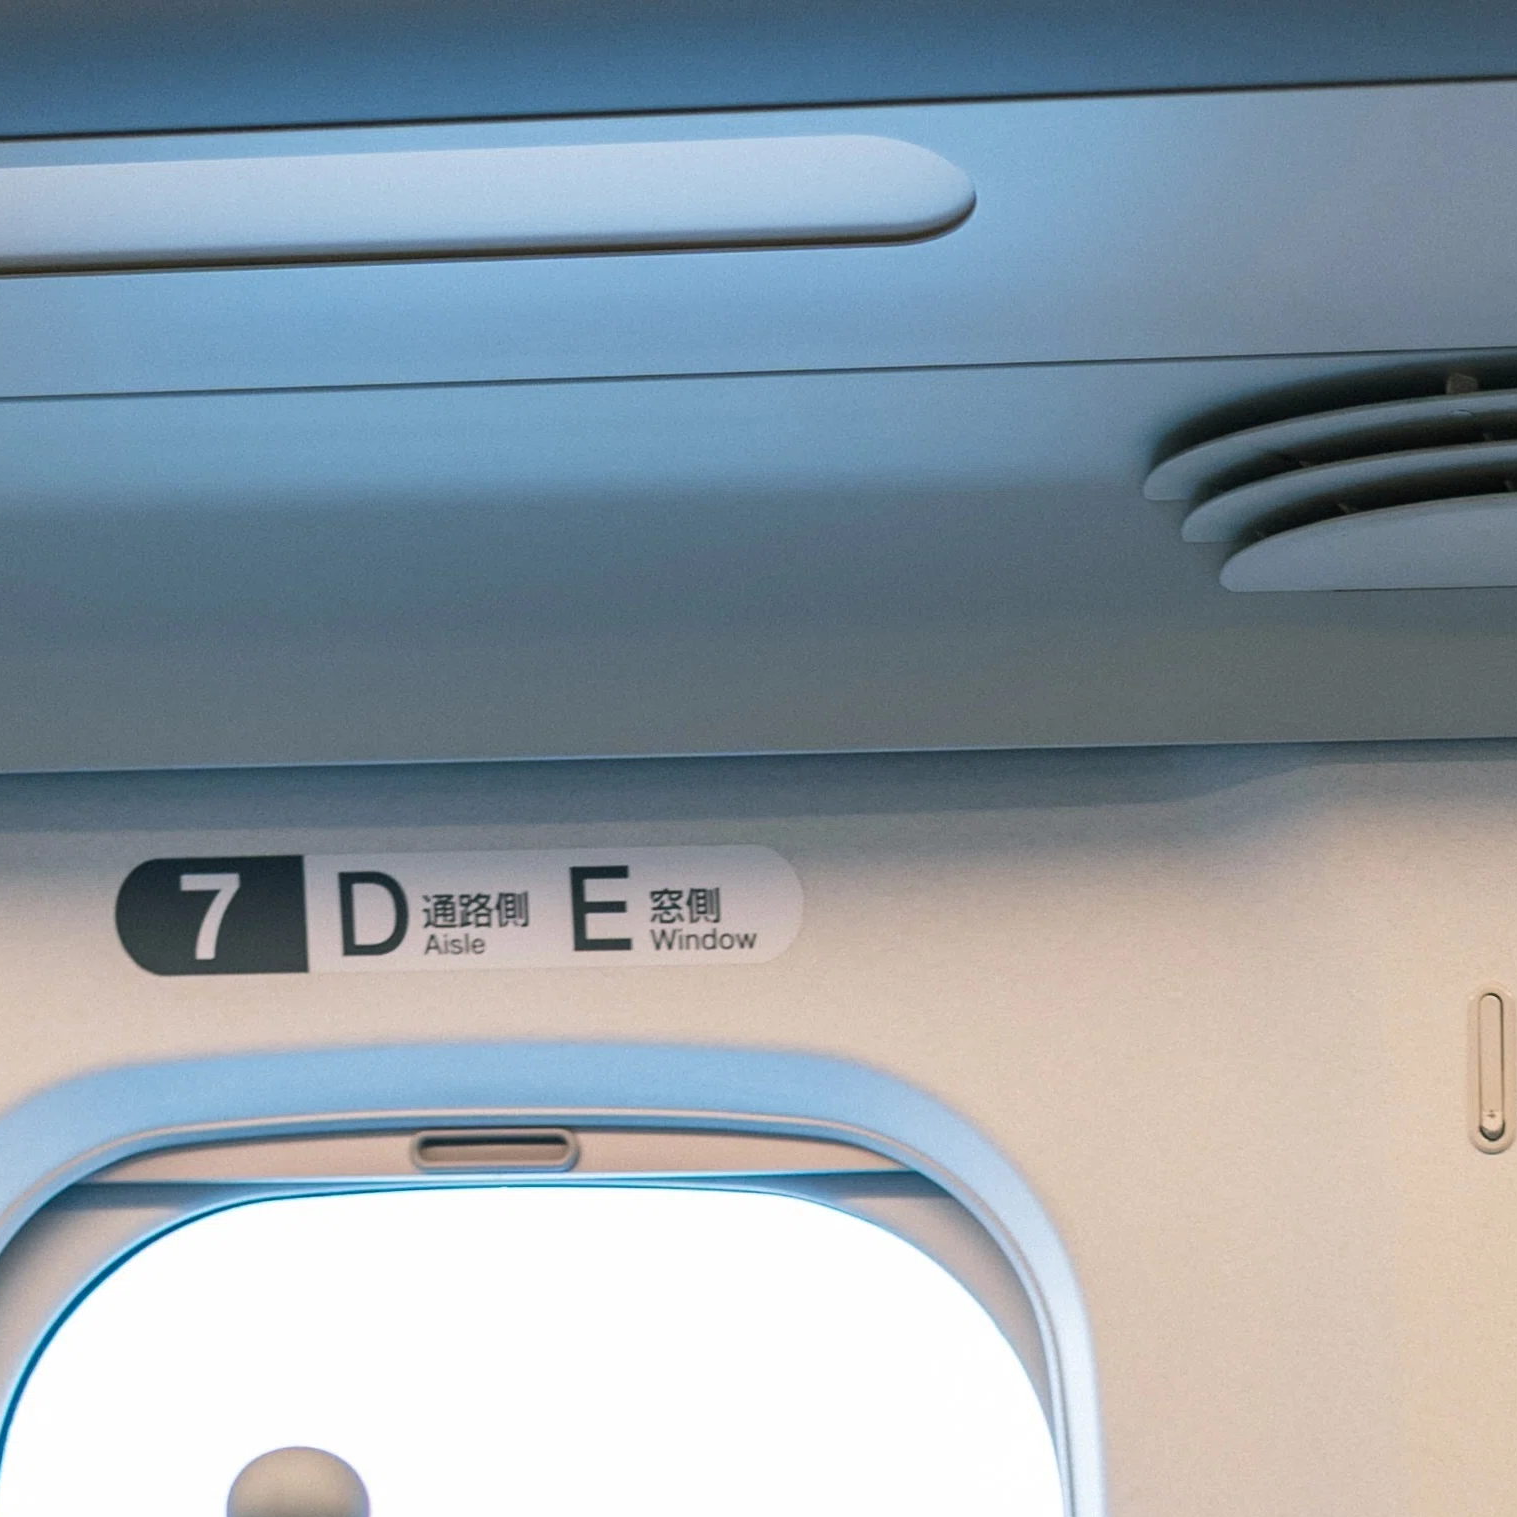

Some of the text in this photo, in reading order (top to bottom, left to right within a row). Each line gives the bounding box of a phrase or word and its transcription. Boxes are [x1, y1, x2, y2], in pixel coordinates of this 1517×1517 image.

[180, 864, 721, 961] 7 D 通路側 E 窓側
[424, 933, 486, 955] Aisle
[650, 927, 757, 951] Window
